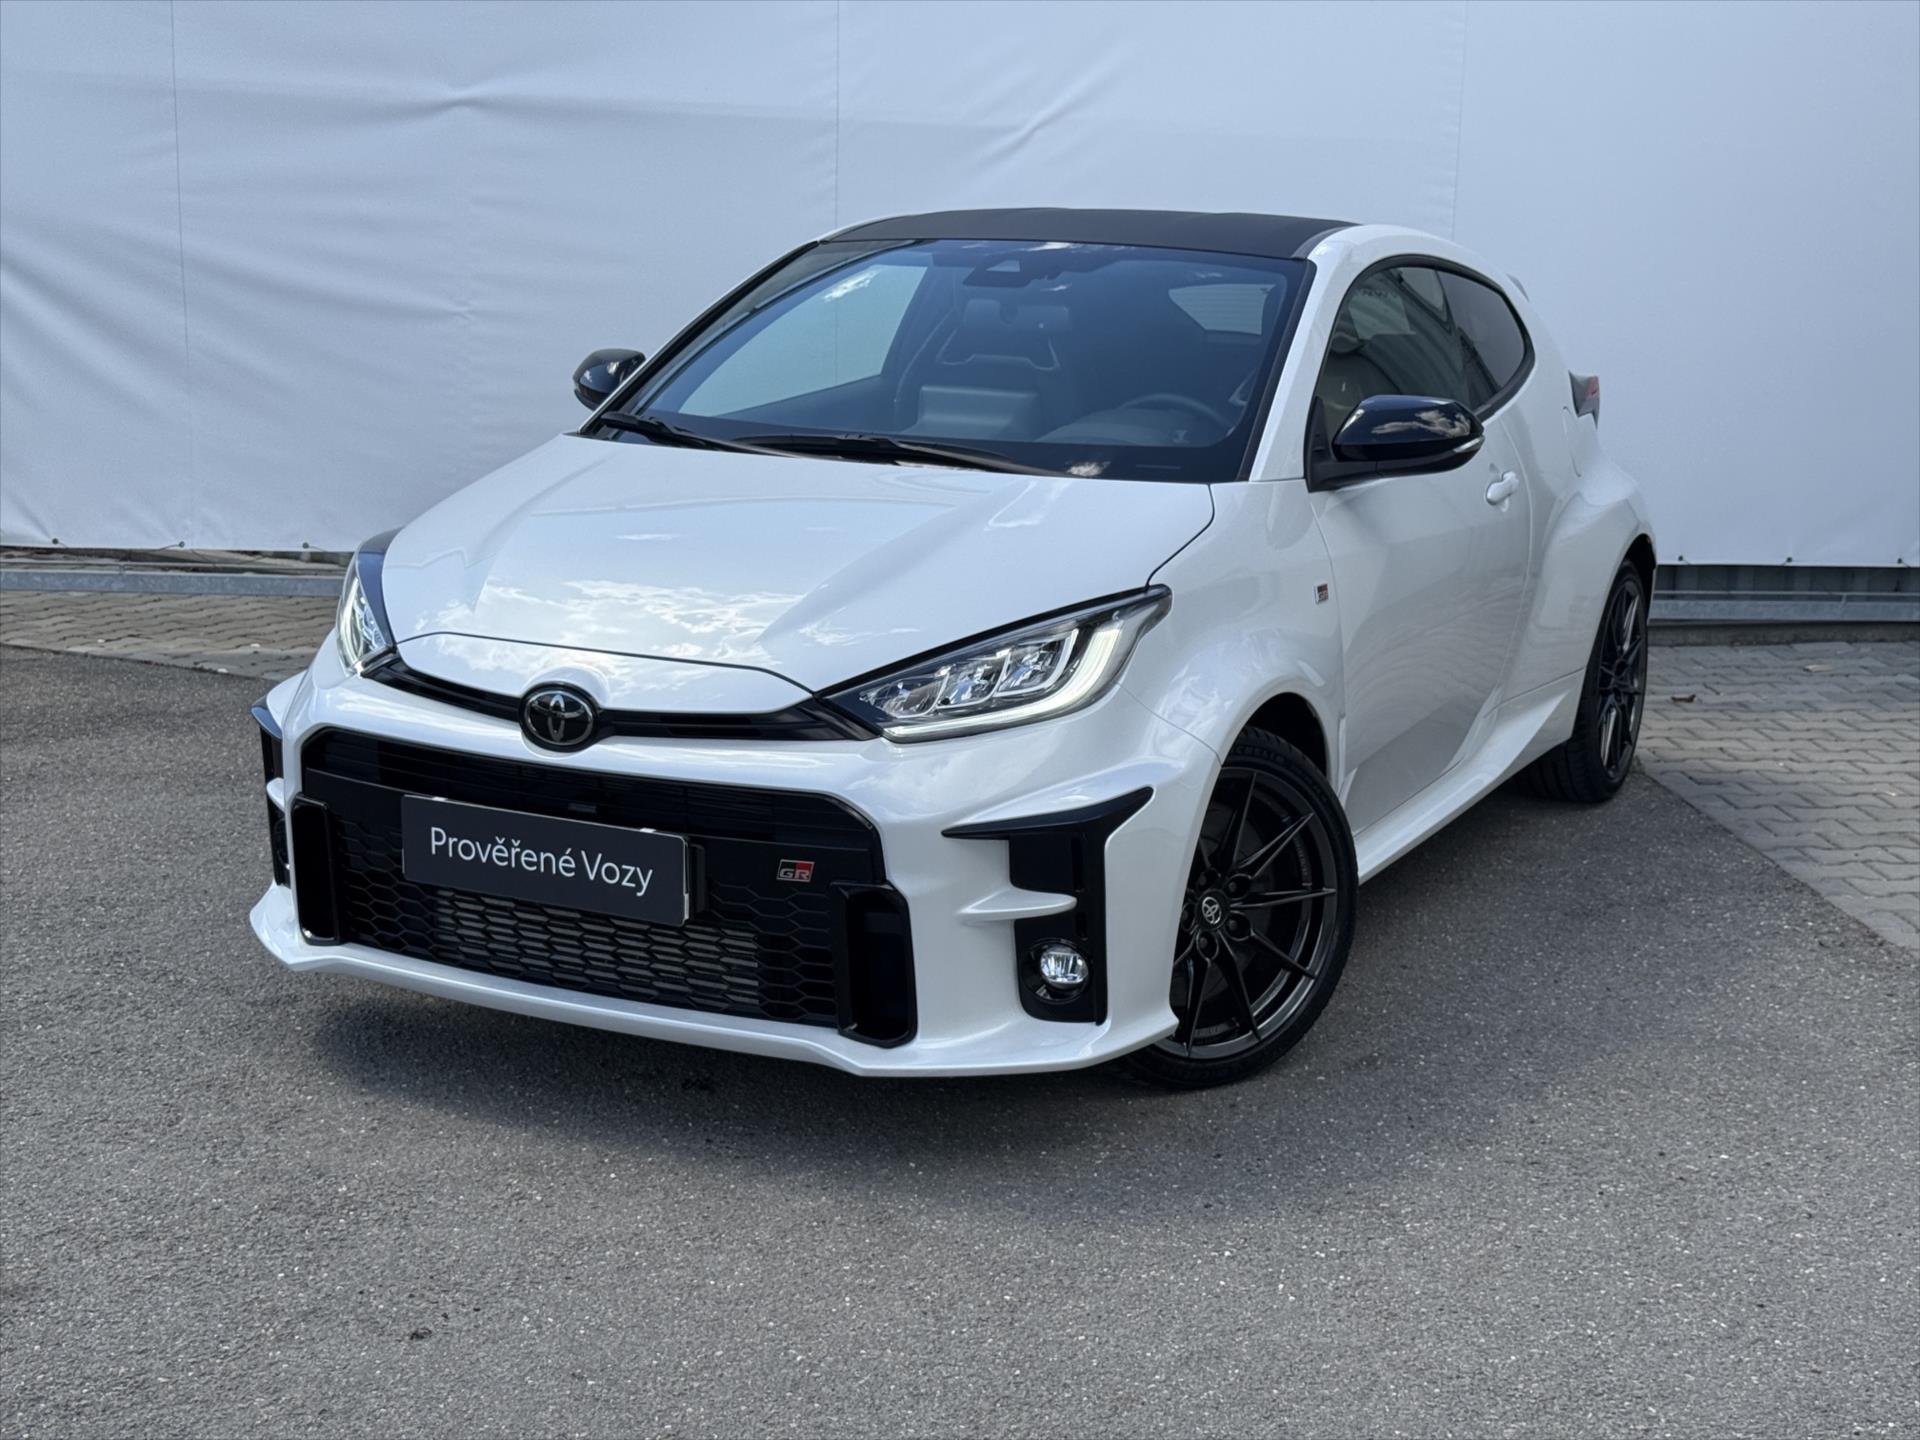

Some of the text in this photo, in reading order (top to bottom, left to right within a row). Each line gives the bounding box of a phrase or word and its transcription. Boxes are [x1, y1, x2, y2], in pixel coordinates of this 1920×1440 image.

[430, 826, 653, 897] Prověřené Vozy
[779, 867, 811, 881] GR
